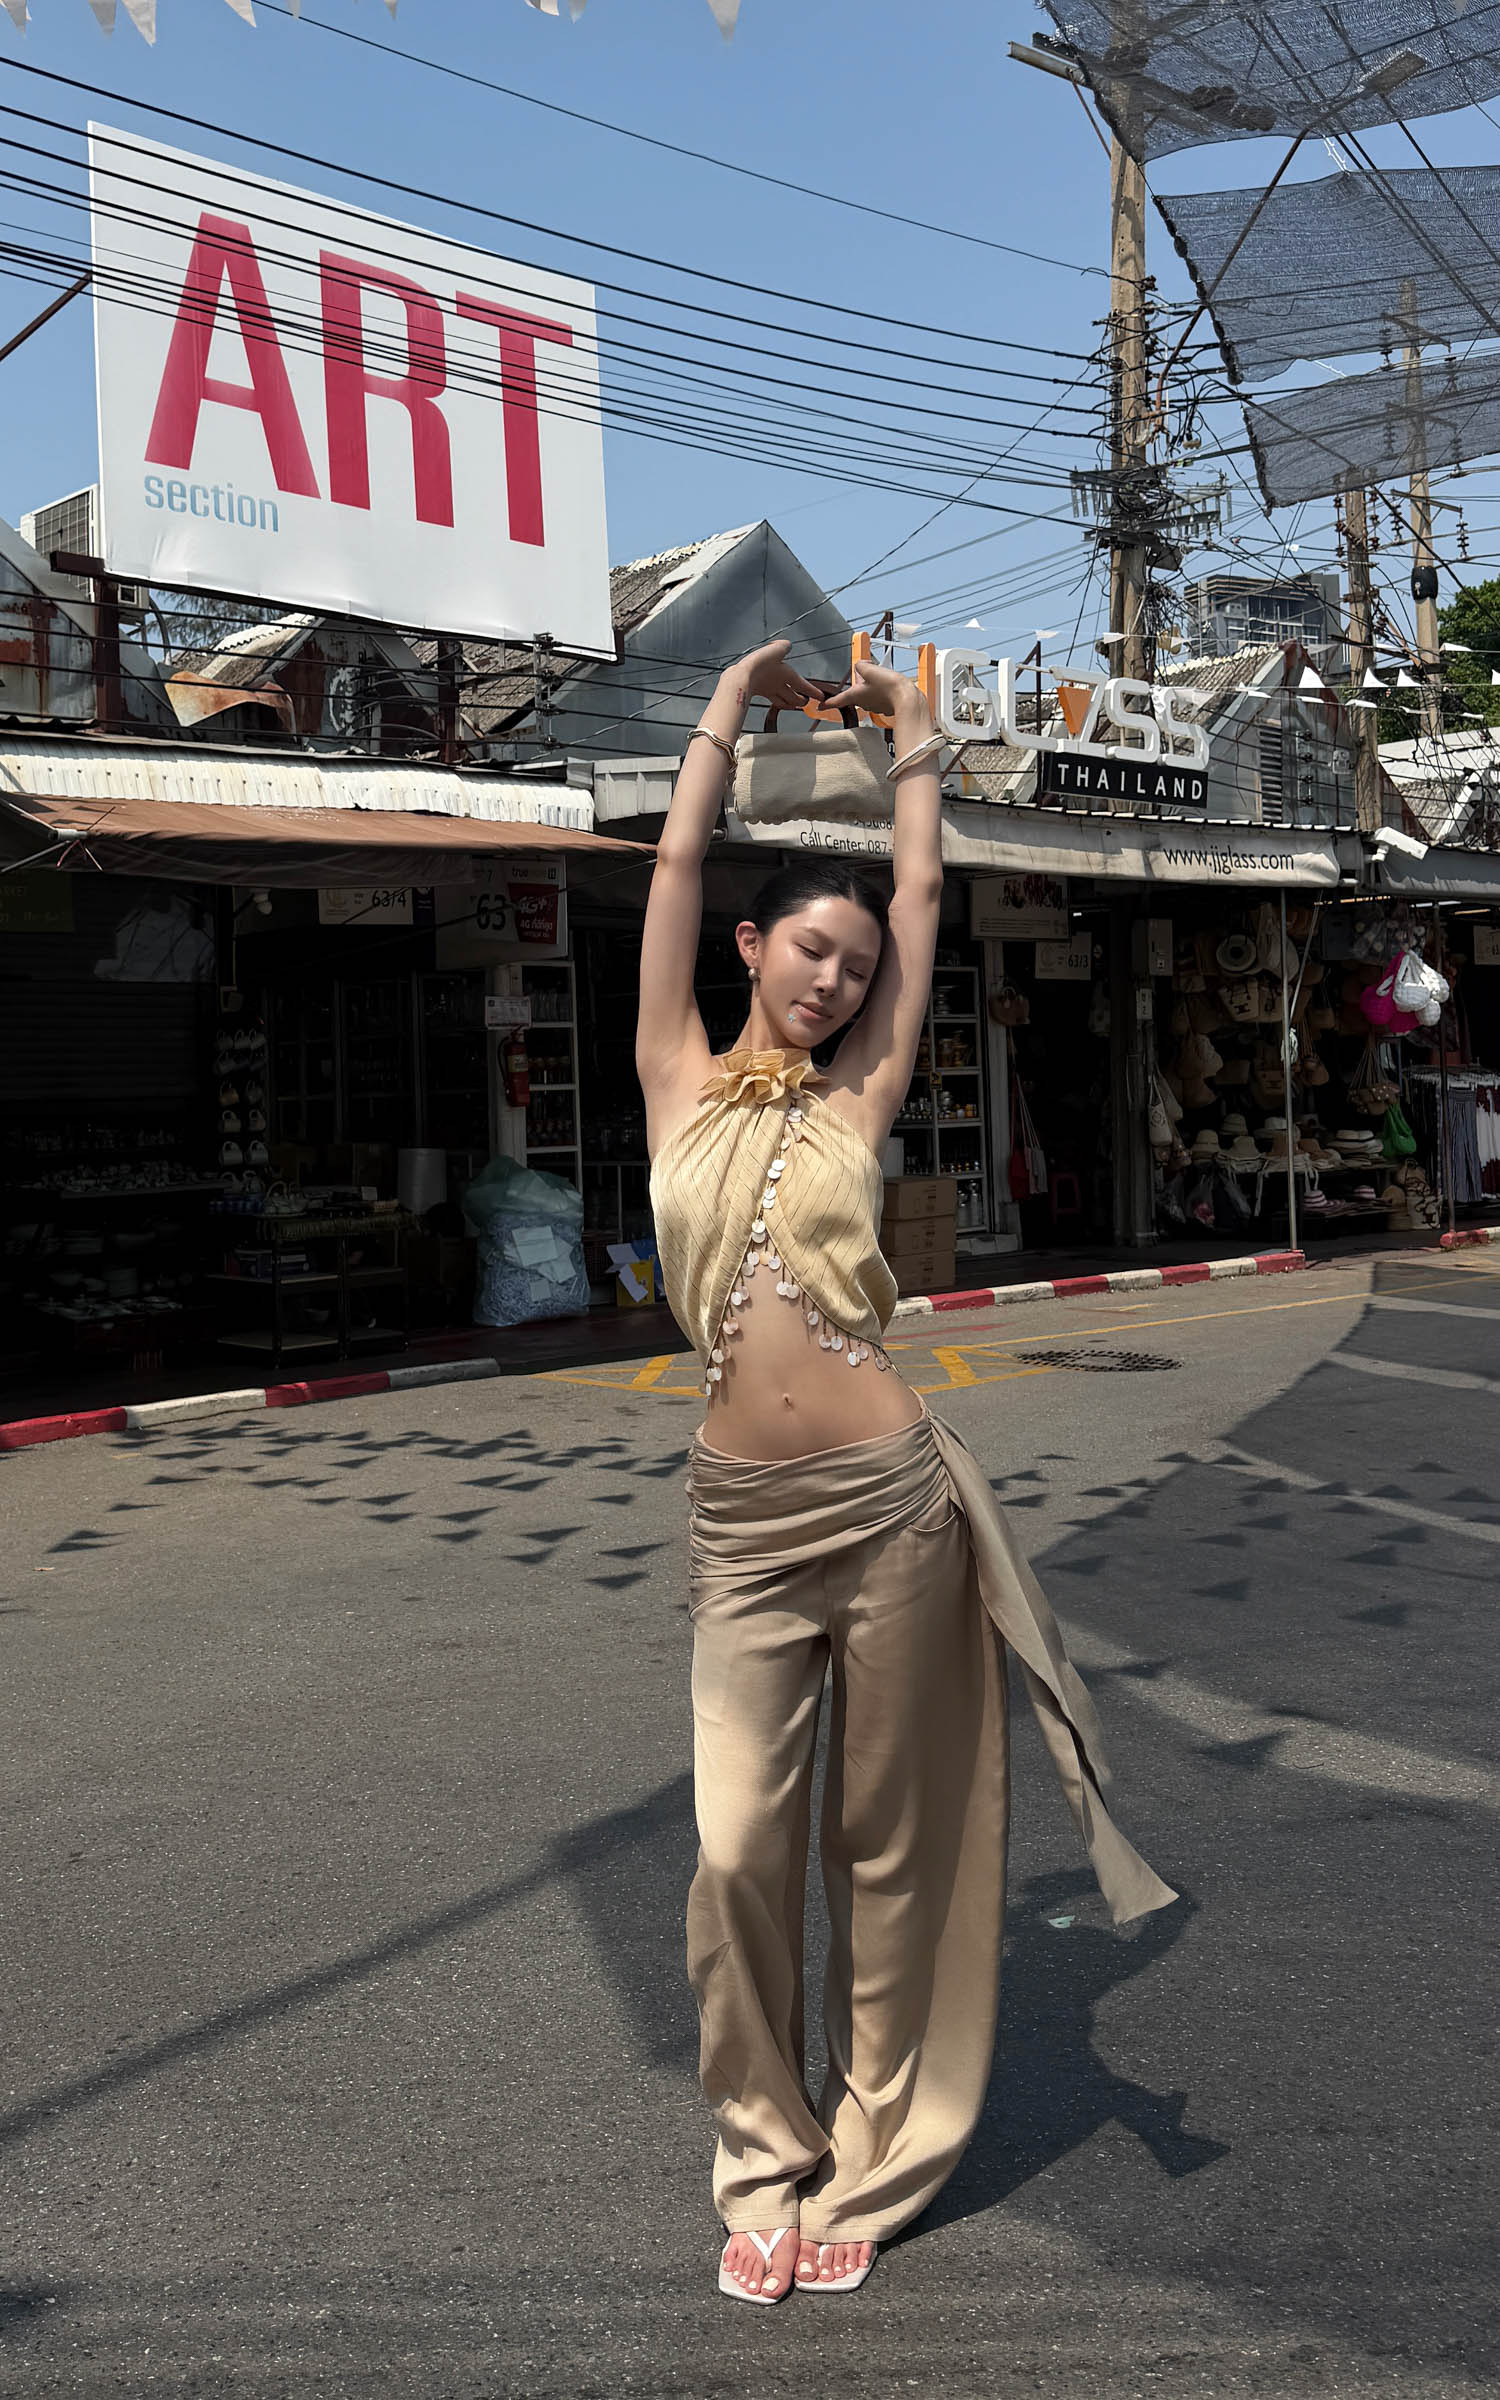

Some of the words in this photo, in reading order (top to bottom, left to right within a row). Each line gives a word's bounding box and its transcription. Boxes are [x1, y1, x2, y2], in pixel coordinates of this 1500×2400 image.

[144, 211, 573, 548] ART
[143, 475, 280, 533] section
[1057, 763, 1203, 801] THAILAND
[800, 830, 822, 848] Call
[825, 834, 866, 852] Center:
[1162, 844, 1295, 875] www.jjglass.com
[477, 893, 506, 931] 63
